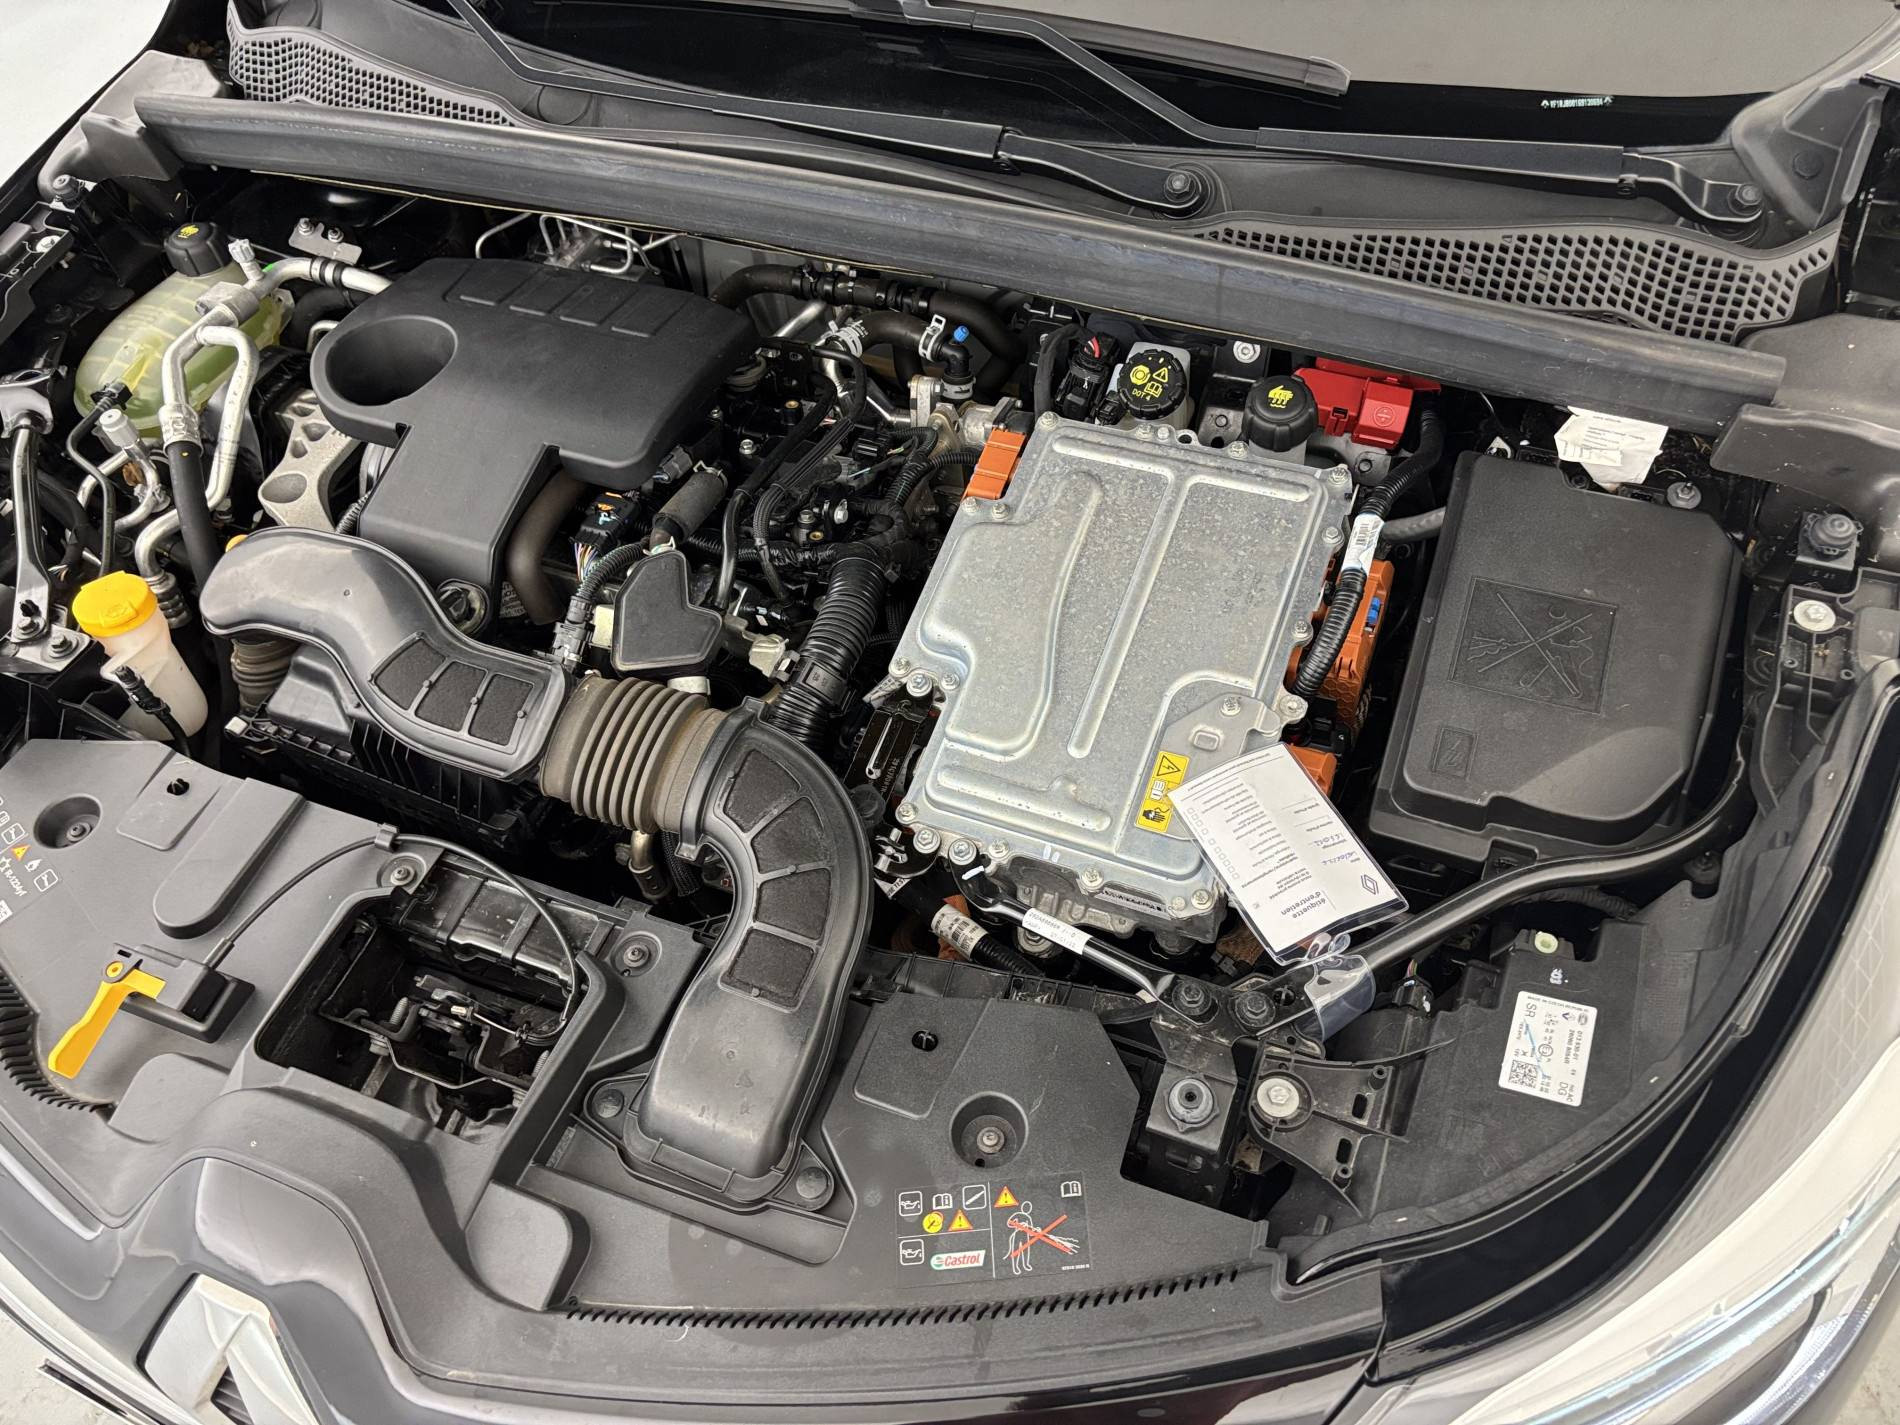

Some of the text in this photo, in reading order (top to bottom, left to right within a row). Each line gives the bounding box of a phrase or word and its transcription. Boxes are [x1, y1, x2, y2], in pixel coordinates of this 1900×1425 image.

[1132, 388, 1146, 399] DOT
[1279, 890, 1322, 917] d'entretien
[1290, 896, 1327, 920] étiquette
[1523, 1001, 1537, 1018] SR
[1556, 1080, 1569, 1097] DG
[944, 1253, 980, 1265] Castrol
